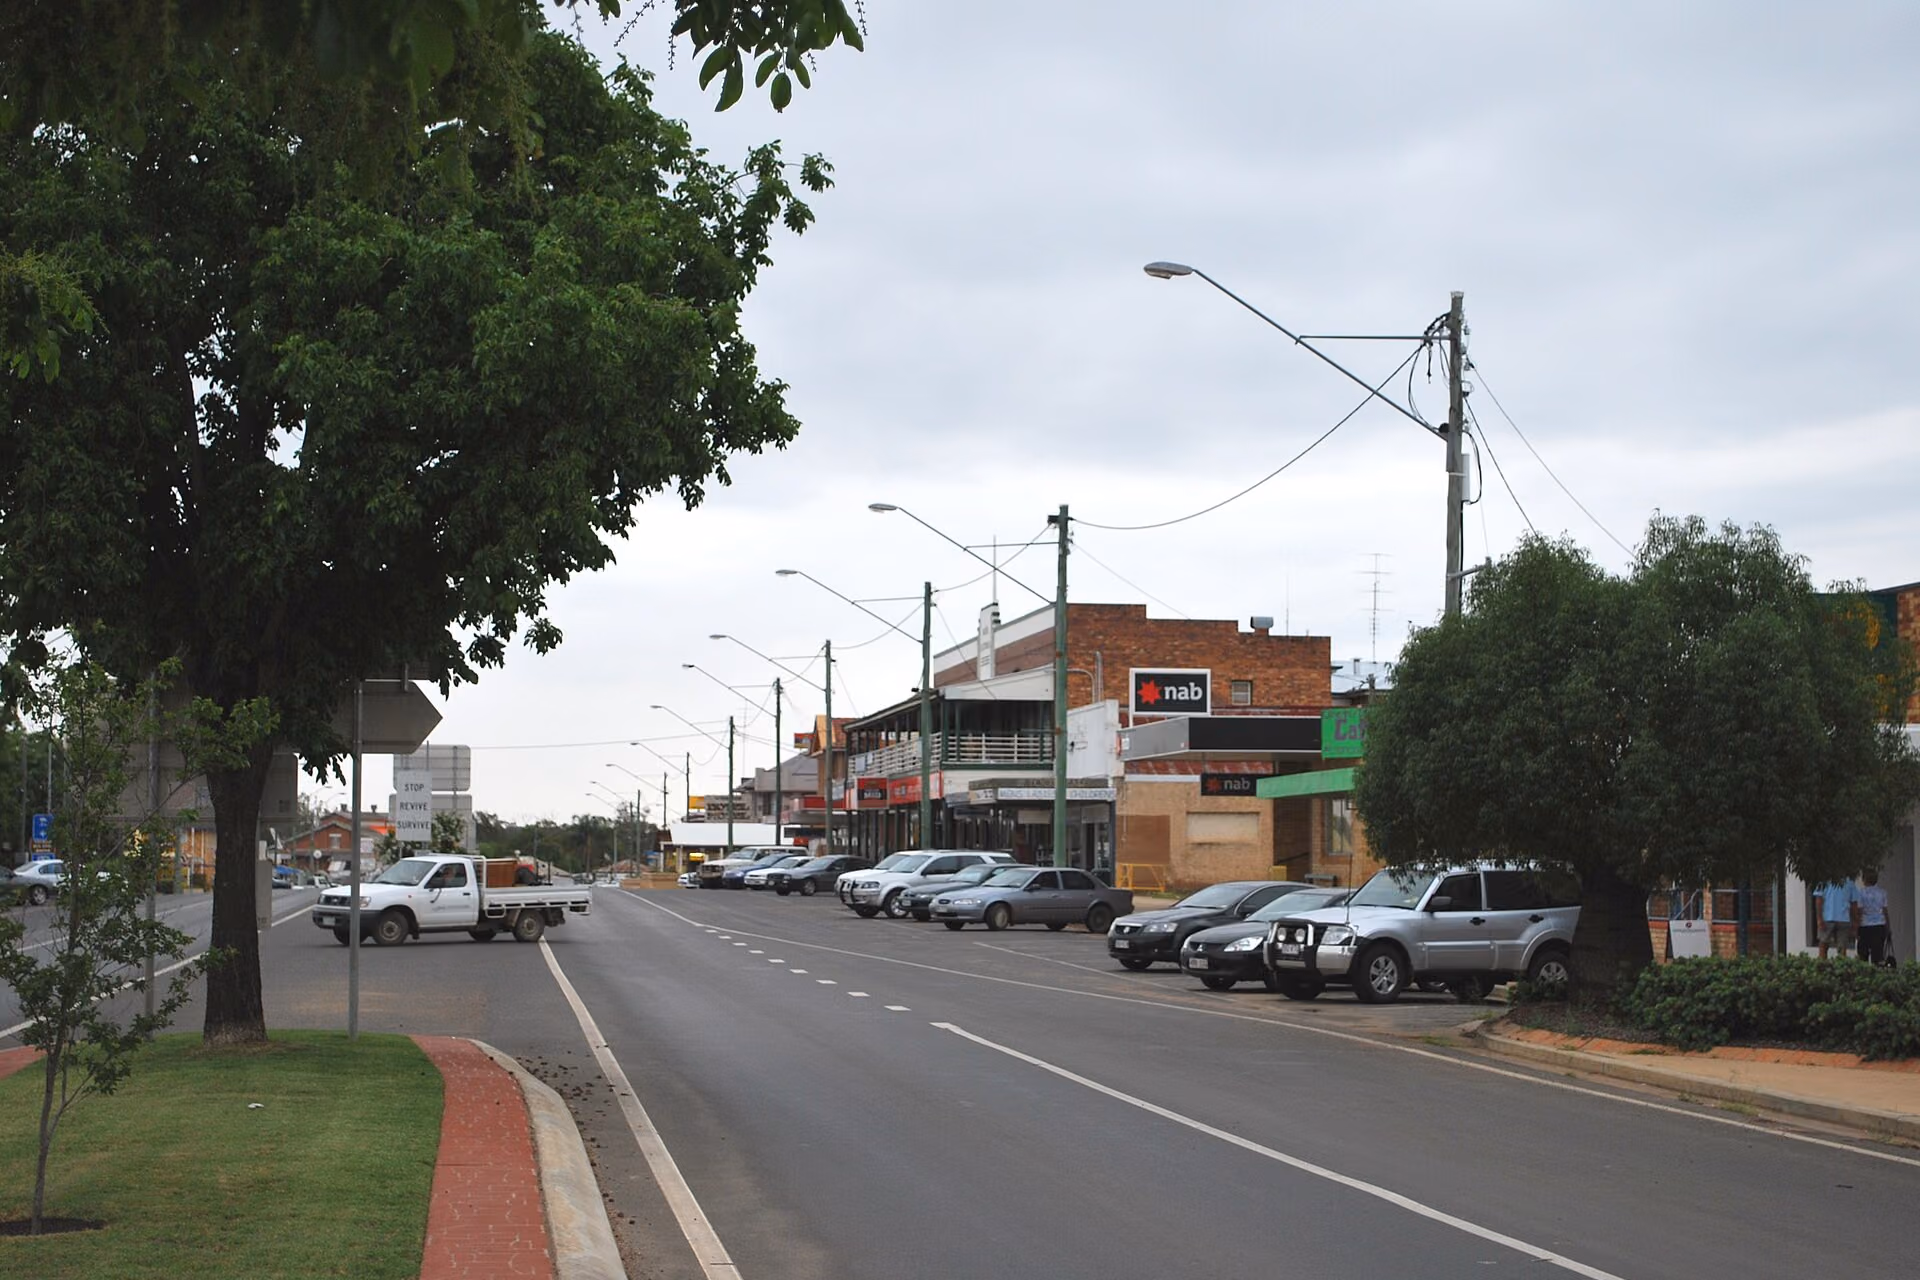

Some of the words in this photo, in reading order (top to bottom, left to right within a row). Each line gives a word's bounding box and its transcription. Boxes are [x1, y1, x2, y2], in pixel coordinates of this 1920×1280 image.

[1164, 681, 1203, 701] nab
[404, 783, 425, 792] STOP
[1224, 777, 1251, 790] nab
[399, 801, 428, 811] REVIVE
[396, 820, 431, 830] SURVIVE
